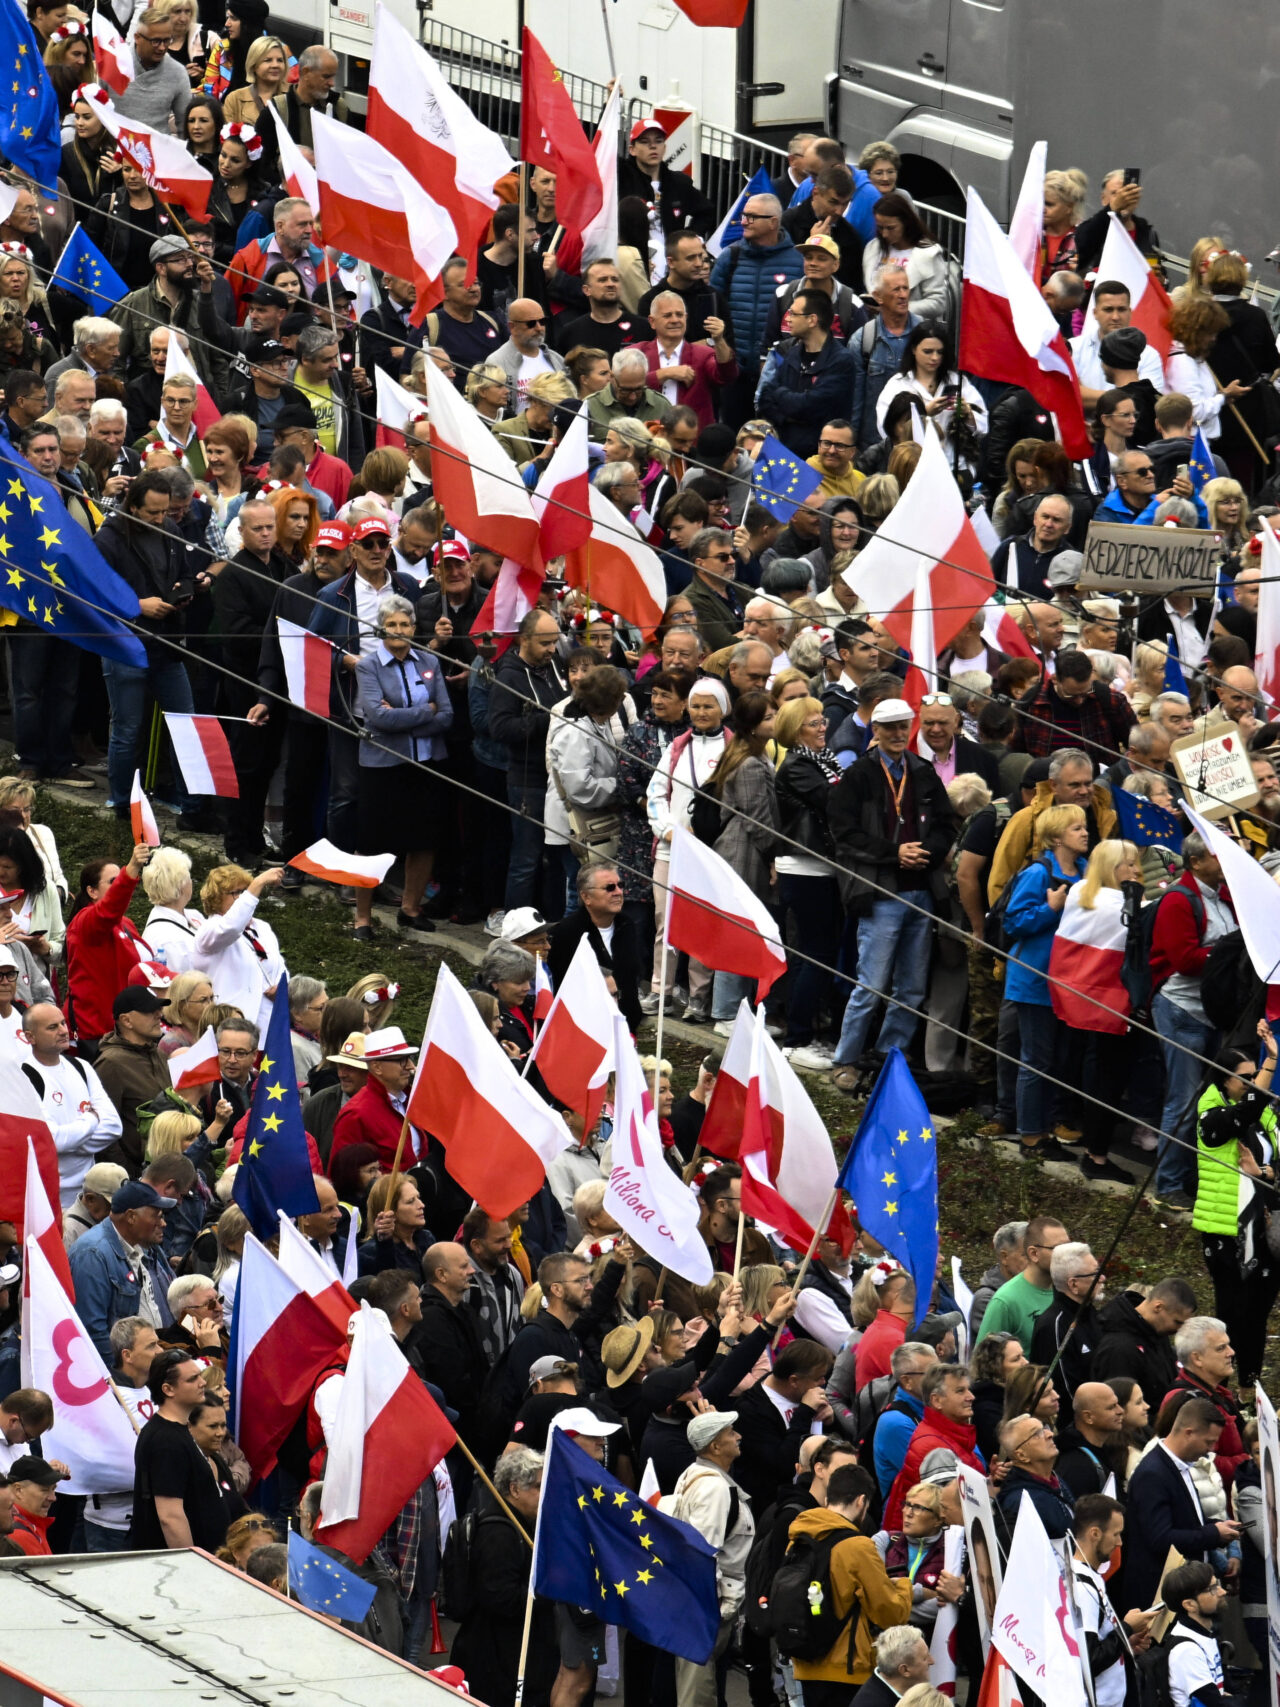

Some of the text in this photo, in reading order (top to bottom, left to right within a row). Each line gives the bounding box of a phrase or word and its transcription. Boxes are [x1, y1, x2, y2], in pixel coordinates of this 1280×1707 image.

[318, 528, 343, 540] POLSKA
[360, 520, 387, 531] POLSKA
[1086, 537, 1219, 580] KĘDZIERZYN-KOŹLE
[610, 1166, 655, 1223] Miliona
[999, 1613, 1036, 1665] Marsz
